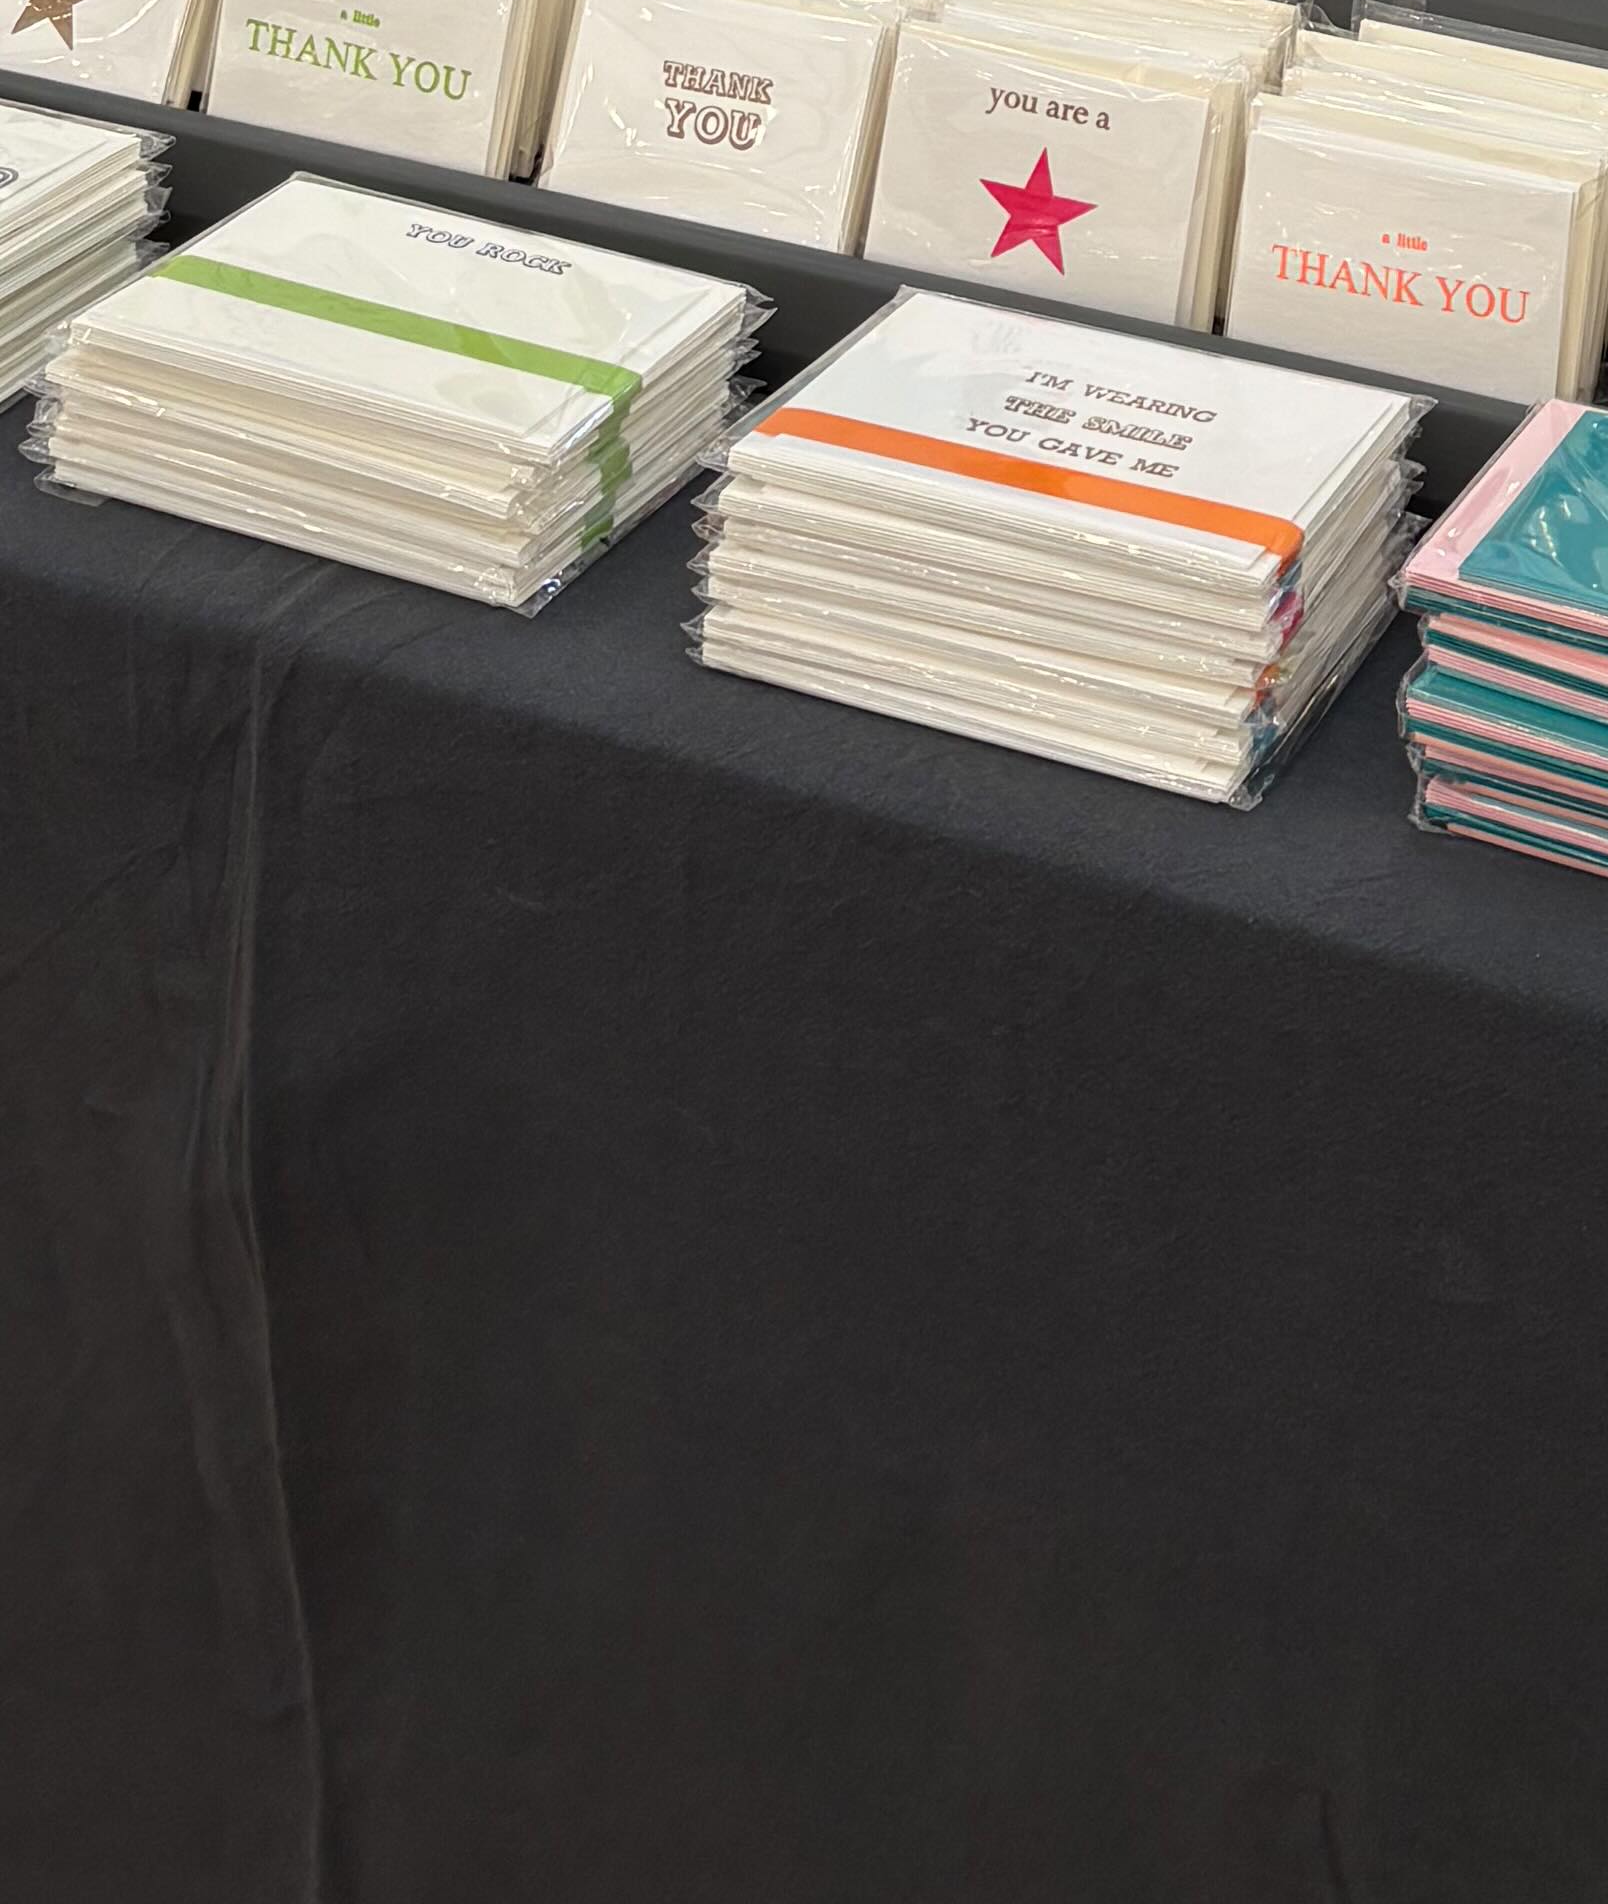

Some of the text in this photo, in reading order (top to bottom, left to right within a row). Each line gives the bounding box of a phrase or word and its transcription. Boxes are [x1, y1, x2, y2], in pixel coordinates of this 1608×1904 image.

[245, 18, 472, 102] THANK YOU
[662, 59, 774, 106] THANK
[664, 96, 764, 151] YOU
[984, 85, 1111, 131] you are a
[406, 223, 572, 276] YOU ROCK
[1271, 244, 1531, 324] THANK YOU
[1004, 395, 1193, 451] THE SMILE
[1025, 371, 1217, 423] I'M WEARING
[966, 417, 1180, 478] YOU GAVE ME
